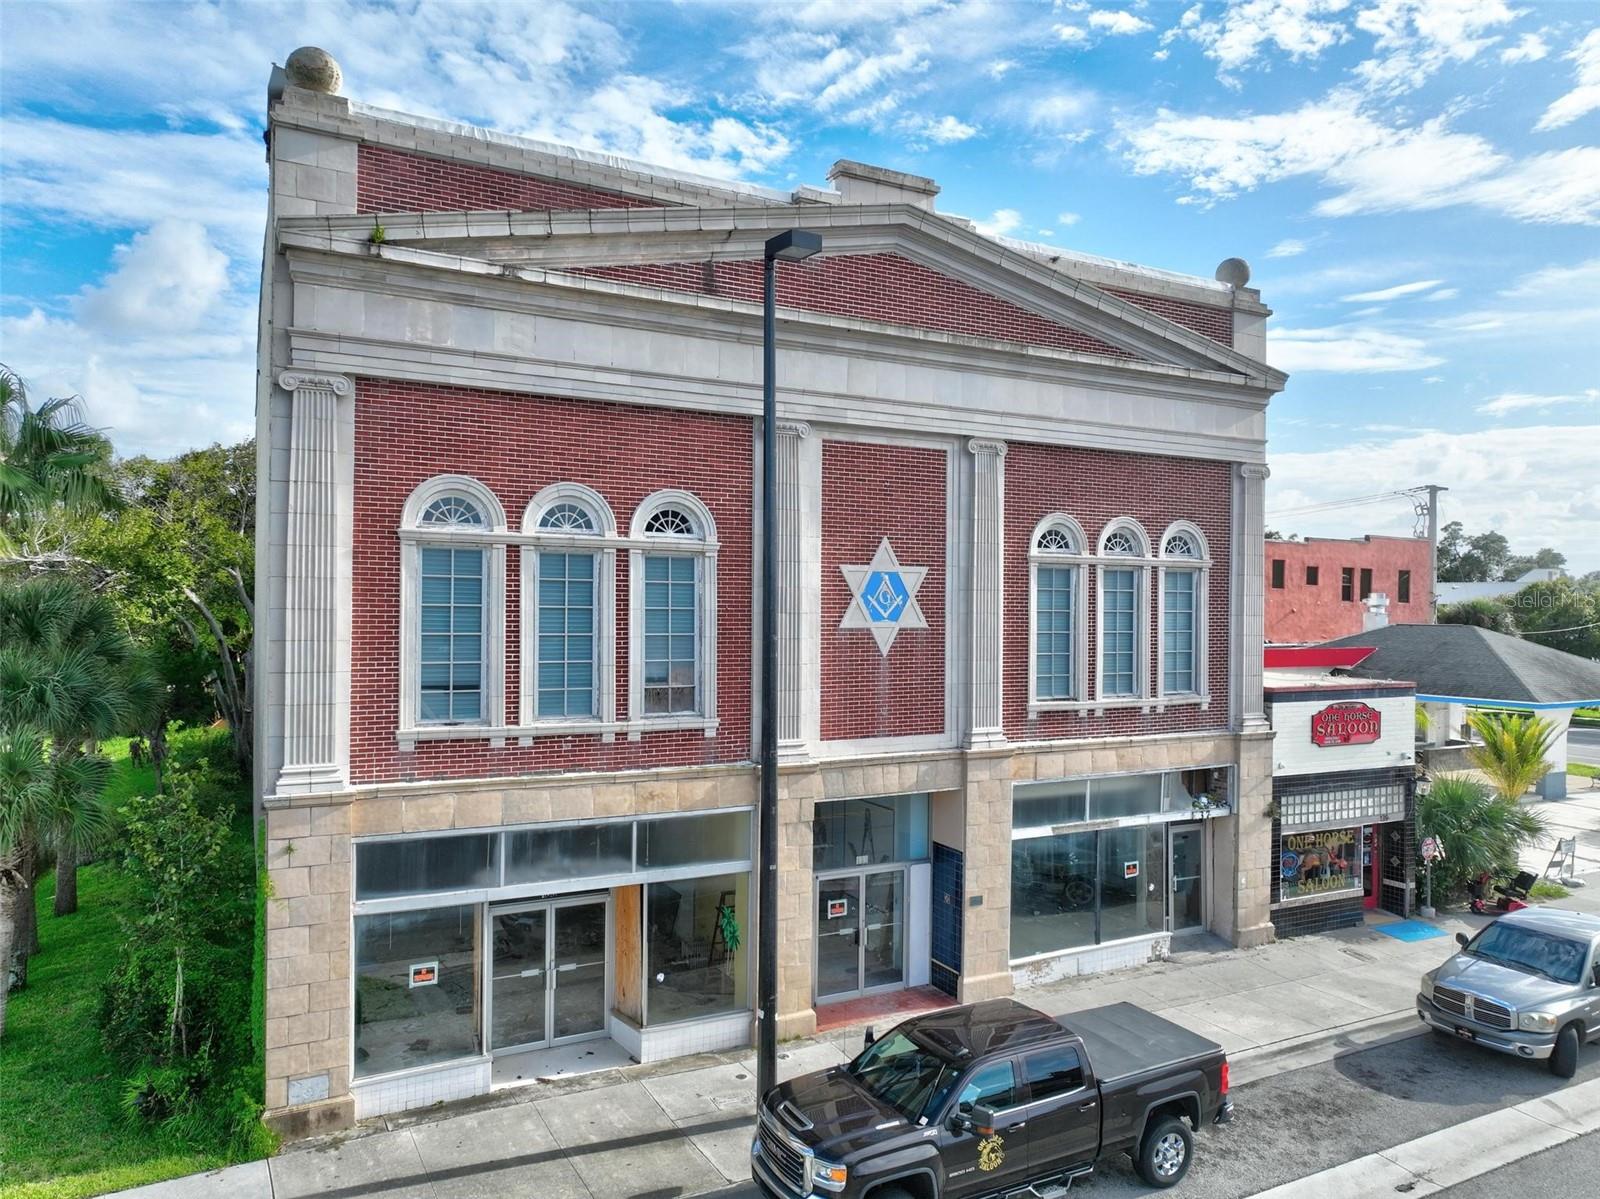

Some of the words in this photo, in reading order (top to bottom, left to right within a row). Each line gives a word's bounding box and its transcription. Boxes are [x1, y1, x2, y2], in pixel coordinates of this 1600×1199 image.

[1316, 720, 1378, 736] SALOON
[1287, 835, 1312, 851] ONE
[1315, 830, 1354, 848] HORSE
[1297, 874, 1345, 893] SALOON
